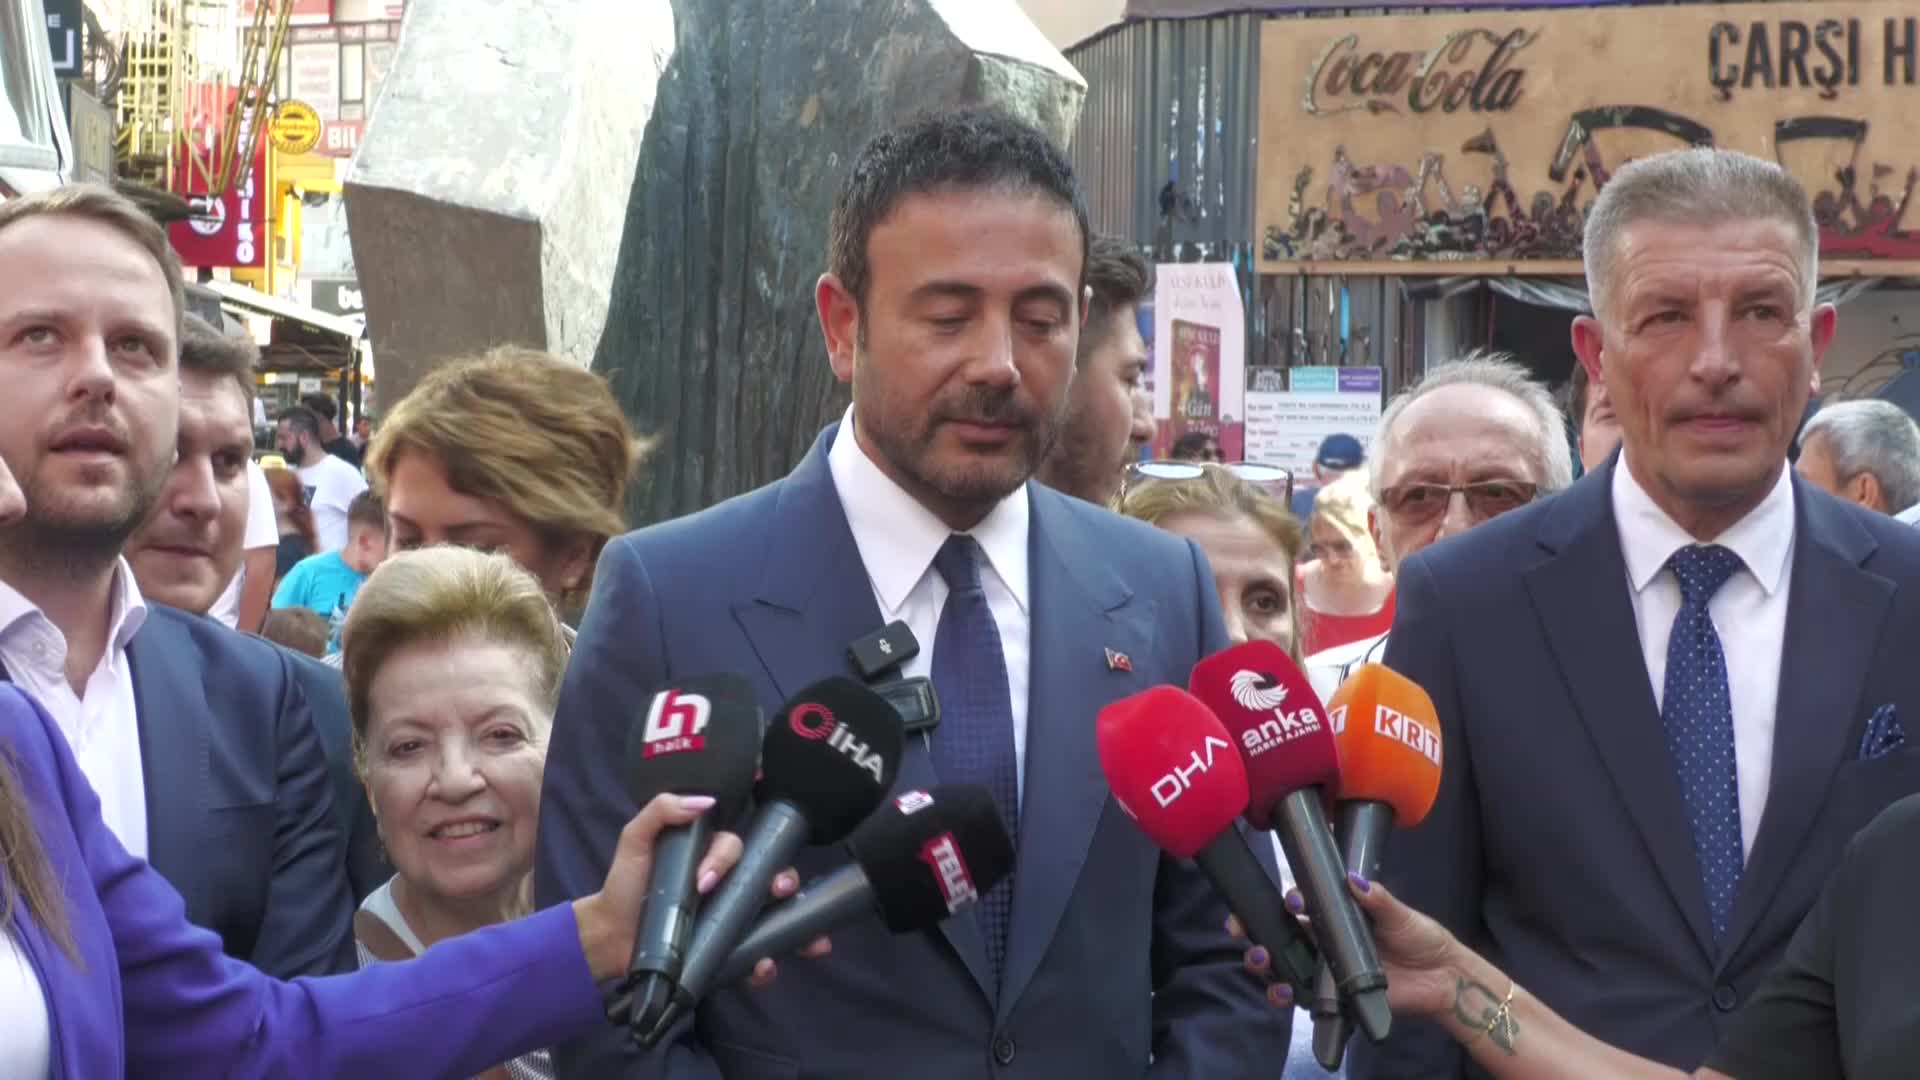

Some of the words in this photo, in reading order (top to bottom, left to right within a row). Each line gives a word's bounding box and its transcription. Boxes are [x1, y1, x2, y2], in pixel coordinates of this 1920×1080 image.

[1708, 18, 1861, 102] ÇARŞI
[828, 720, 883, 785] İHA
[1242, 707, 1319, 748] anka
[1249, 737, 1285, 757] HABER
[1285, 721, 1322, 740] AJANSI
[1376, 704, 1440, 765] KRT
[1150, 735, 1229, 809] DHA
